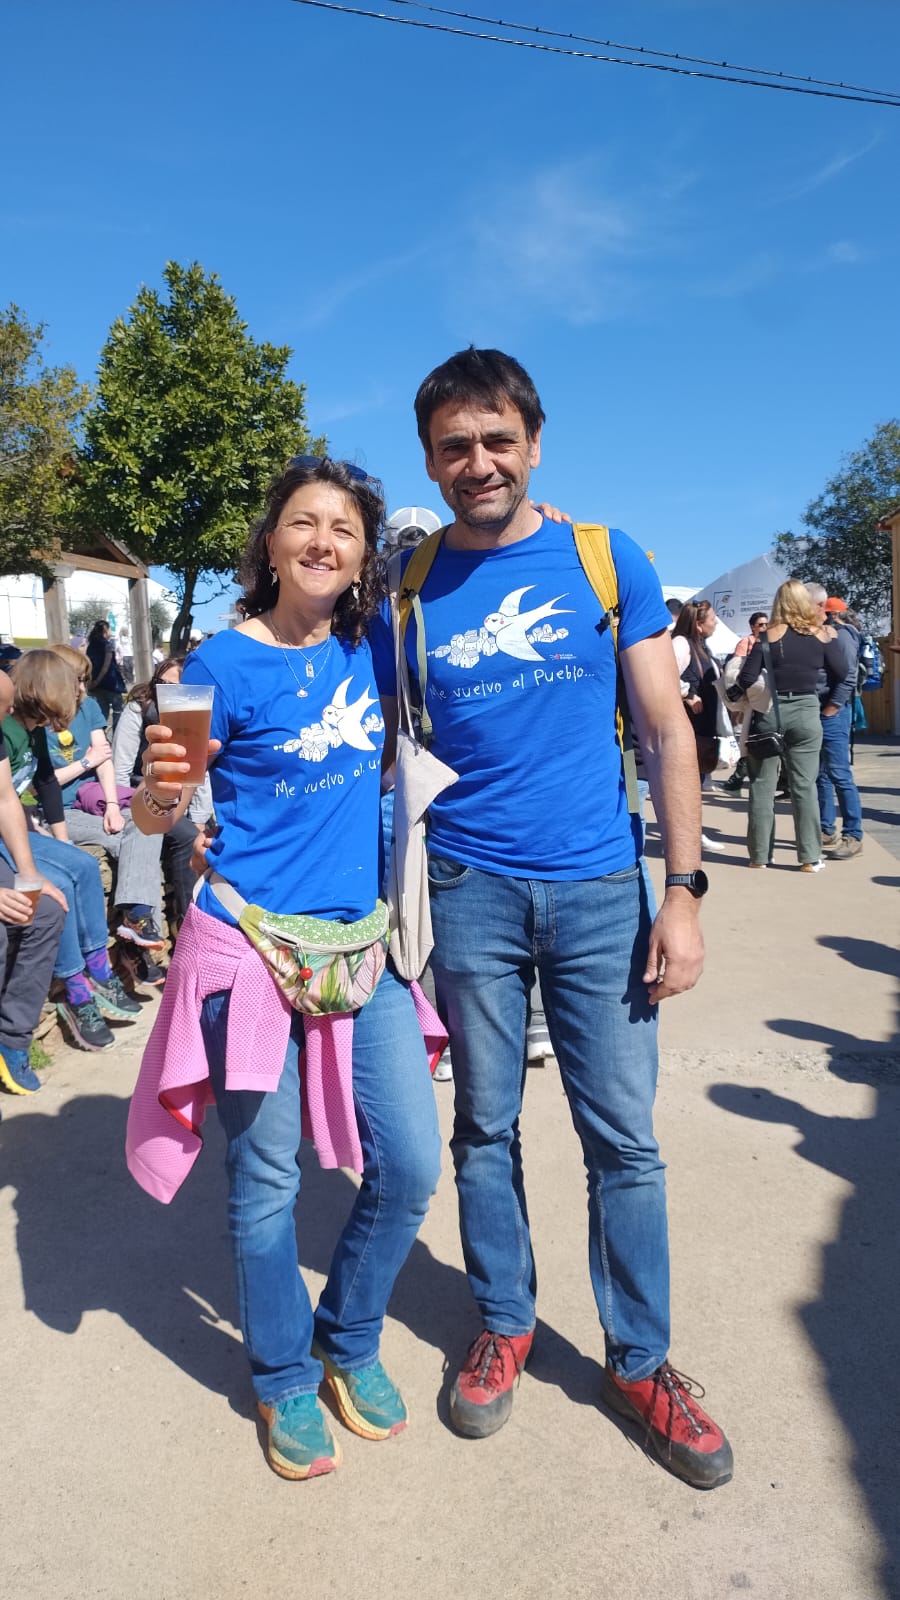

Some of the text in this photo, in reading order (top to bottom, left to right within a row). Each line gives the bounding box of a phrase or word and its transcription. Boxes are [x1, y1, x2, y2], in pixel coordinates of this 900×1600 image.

[430, 664, 595, 701] Me vuelvo al Pueblo...
[275, 778, 296, 798] Me
[304, 772, 344, 793] vuelvo
[353, 762, 363, 777] al
